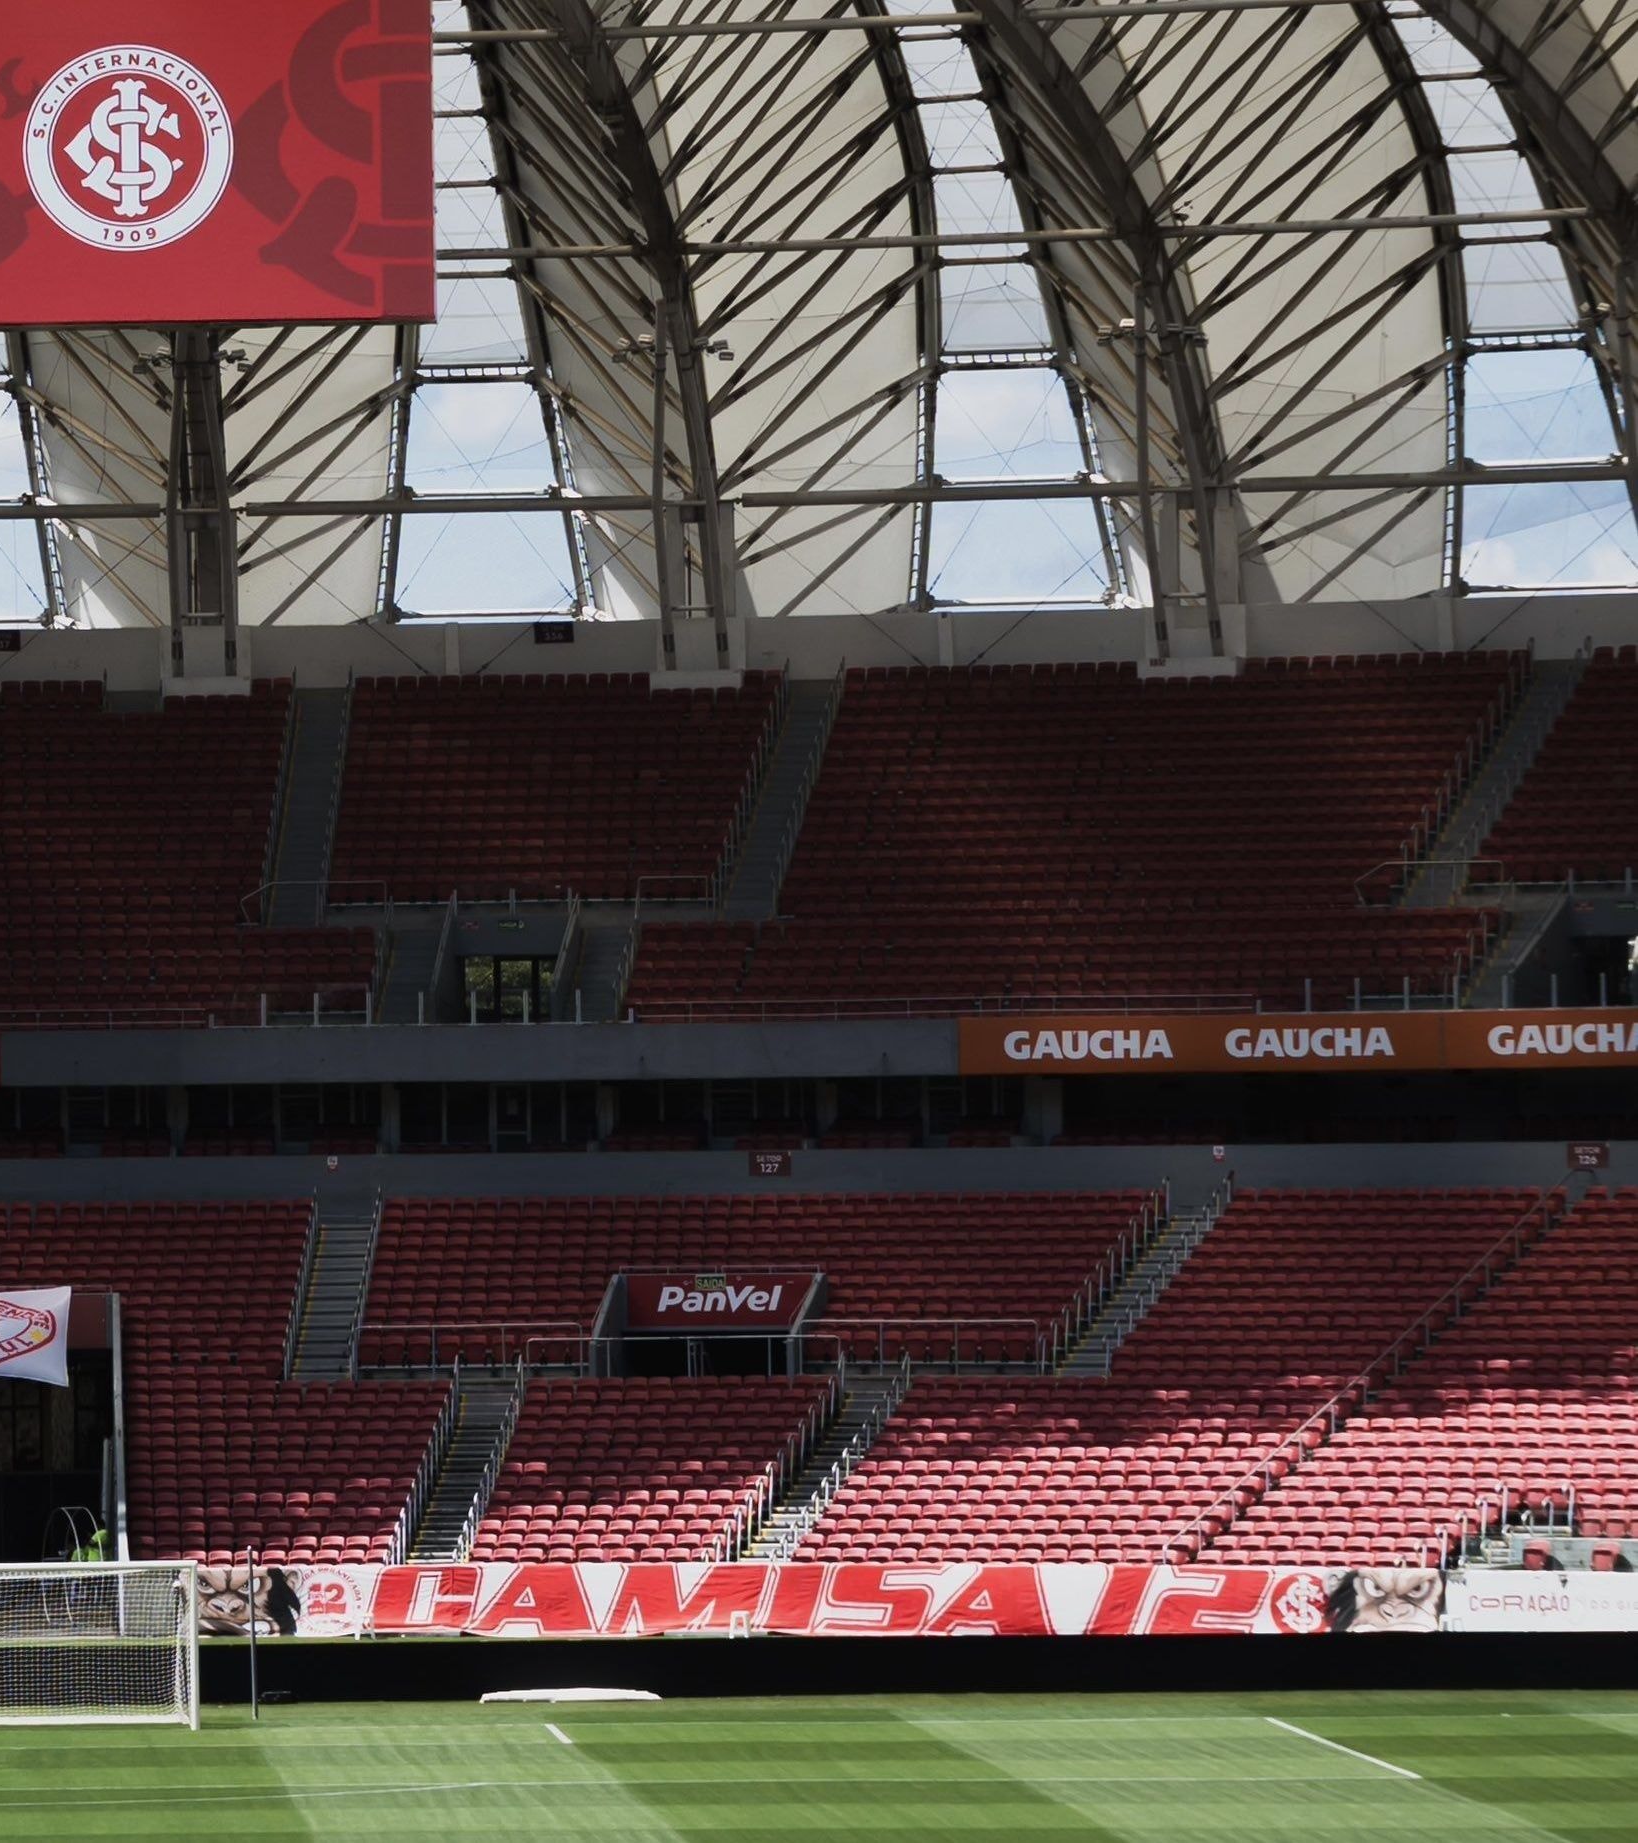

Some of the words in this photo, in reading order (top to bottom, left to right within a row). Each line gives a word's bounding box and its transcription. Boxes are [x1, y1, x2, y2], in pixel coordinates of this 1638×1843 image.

[55, 53, 223, 137] INTERNACIONAL
[102, 227, 157, 242] 1909
[755, 1154, 783, 1163] SETOR
[759, 1163, 779, 1173] 127
[657, 1285, 783, 1313] PanVel
[308, 1583, 347, 1616] 12
[366, 1563, 1056, 1635] CAMISA
